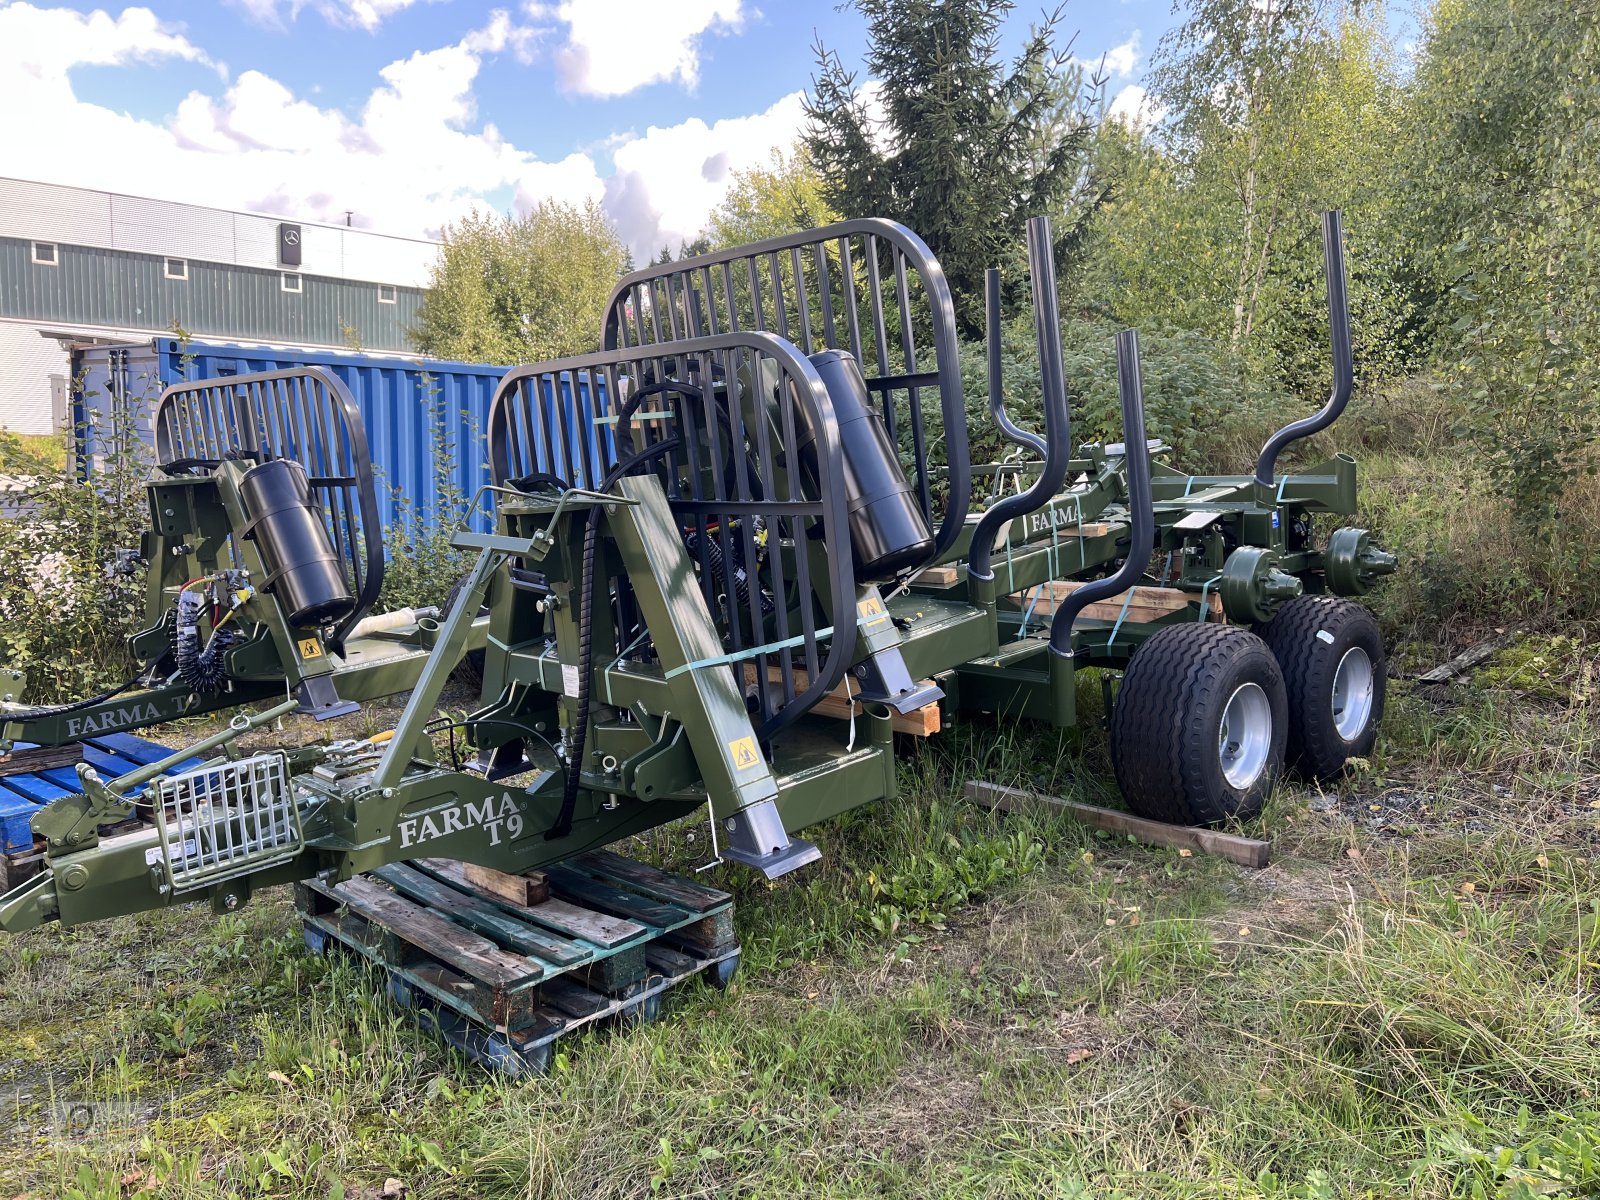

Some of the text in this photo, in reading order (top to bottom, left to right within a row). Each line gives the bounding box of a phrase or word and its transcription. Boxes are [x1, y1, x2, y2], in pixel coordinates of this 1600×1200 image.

[66, 692, 202, 737] FARMA T9
[398, 791, 519, 849] FARMA
[483, 814, 524, 847] T9
